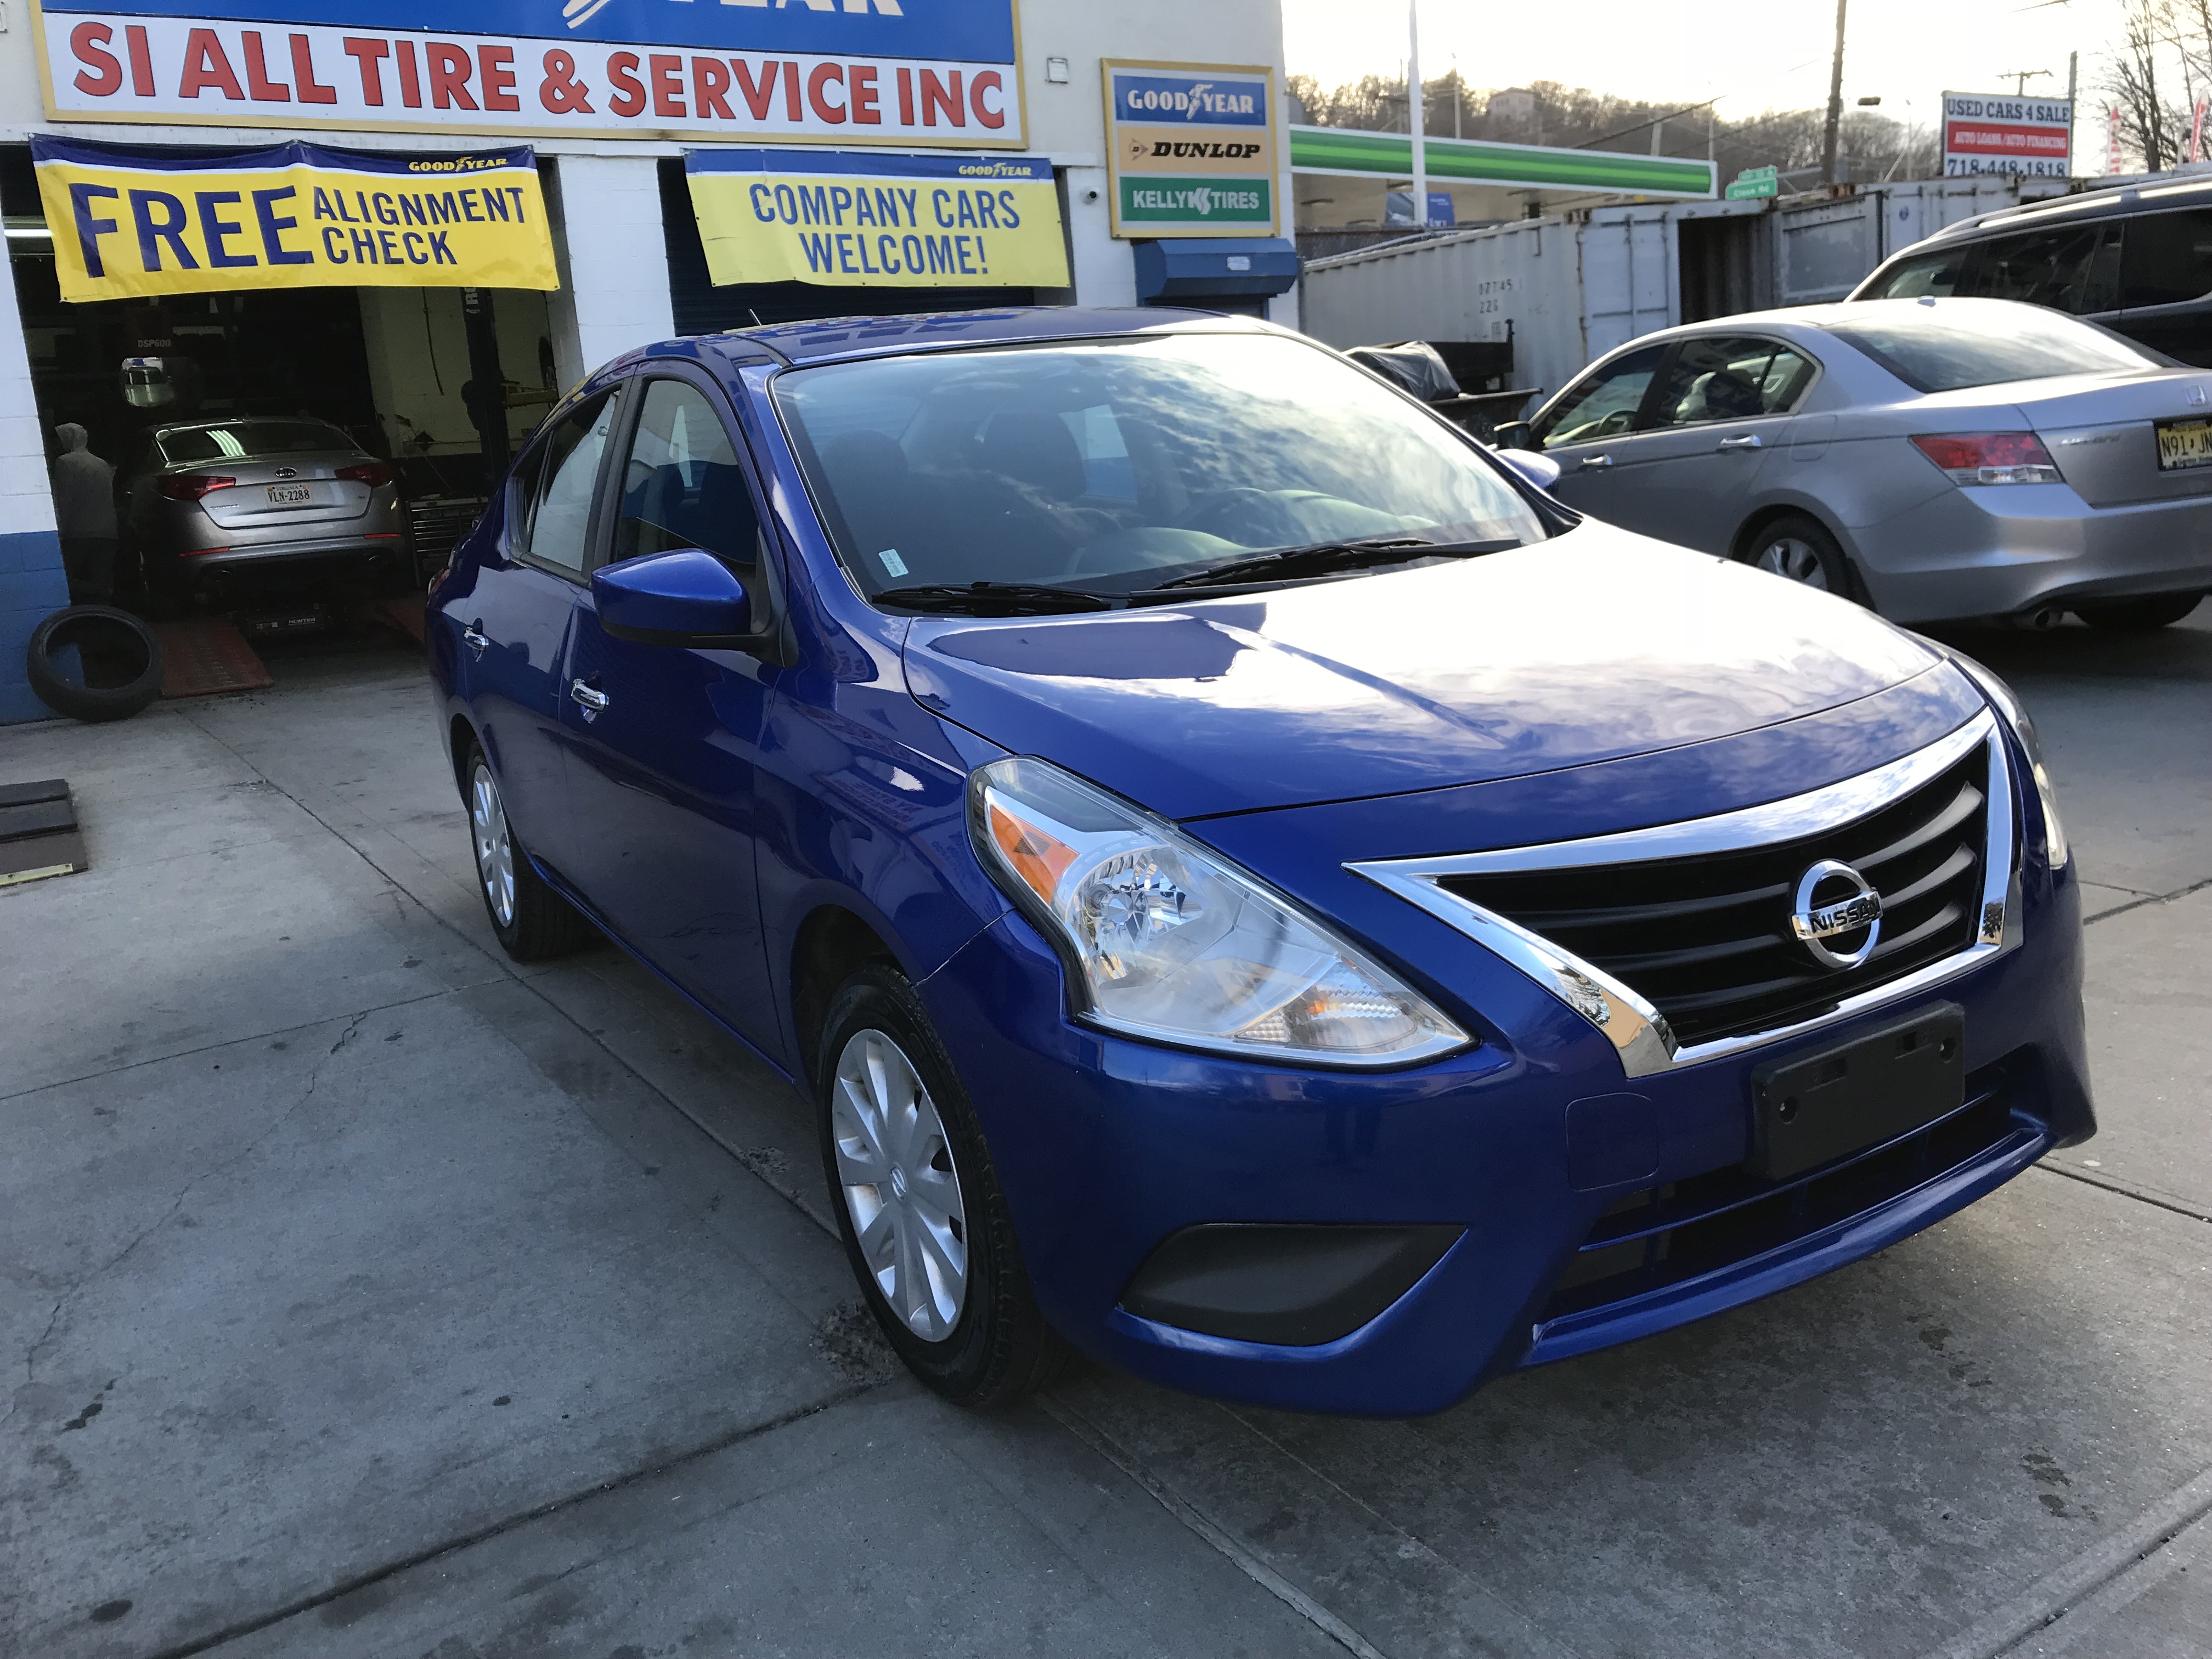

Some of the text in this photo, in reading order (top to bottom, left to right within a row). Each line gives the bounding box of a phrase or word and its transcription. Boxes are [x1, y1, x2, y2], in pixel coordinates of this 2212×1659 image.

[70, 21, 1005, 129] SI ALL TIRE & SERVICE INC
[1947, 98, 2070, 122] USED CARS 4 SALE
[1150, 142, 1261, 159] DUNLOP
[313, 185, 525, 226] ALIGNMENT
[749, 183, 1020, 229] COMPANY CARS
[1132, 190, 1188, 208] KELLY
[1210, 191, 1261, 210] TIRES
[68, 182, 314, 279] FREE
[321, 226, 458, 266] CHECK
[798, 232, 989, 274] WELCOME!
[267, 489, 311, 503] VLN-2288
[1810, 898, 1881, 934] NISSAN
